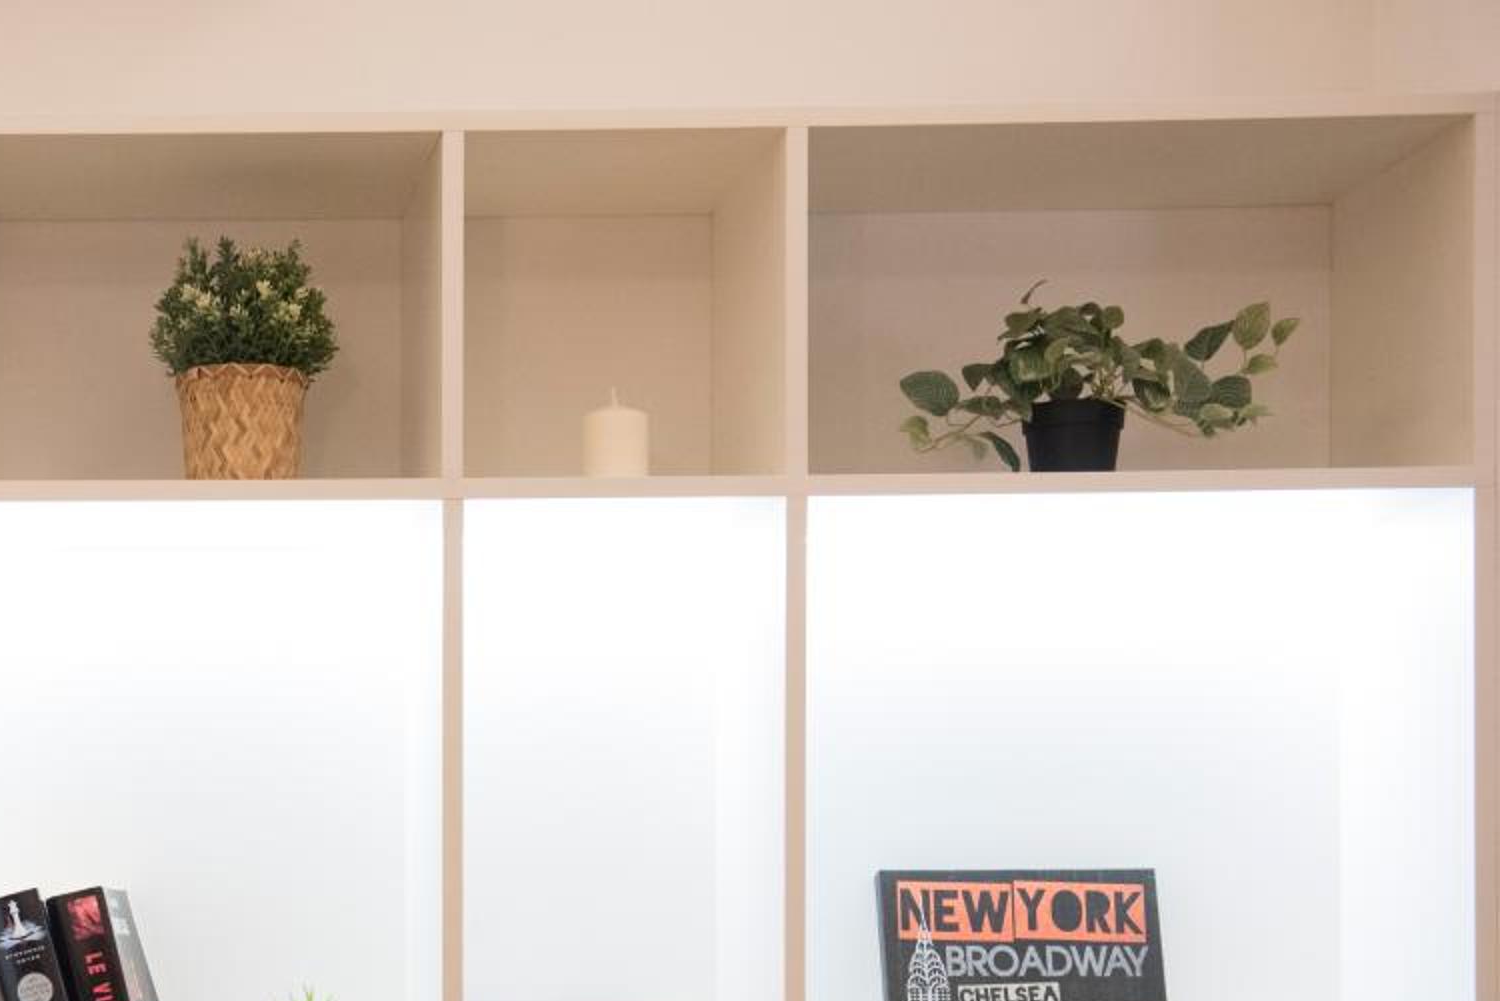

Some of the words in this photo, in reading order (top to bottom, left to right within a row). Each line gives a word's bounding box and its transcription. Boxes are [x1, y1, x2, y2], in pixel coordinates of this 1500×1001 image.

[900, 888, 1009, 933] NEW
[1016, 888, 1143, 935] YORK
[86, 952, 106, 975] LE
[946, 945, 1148, 977] BROADWAY
